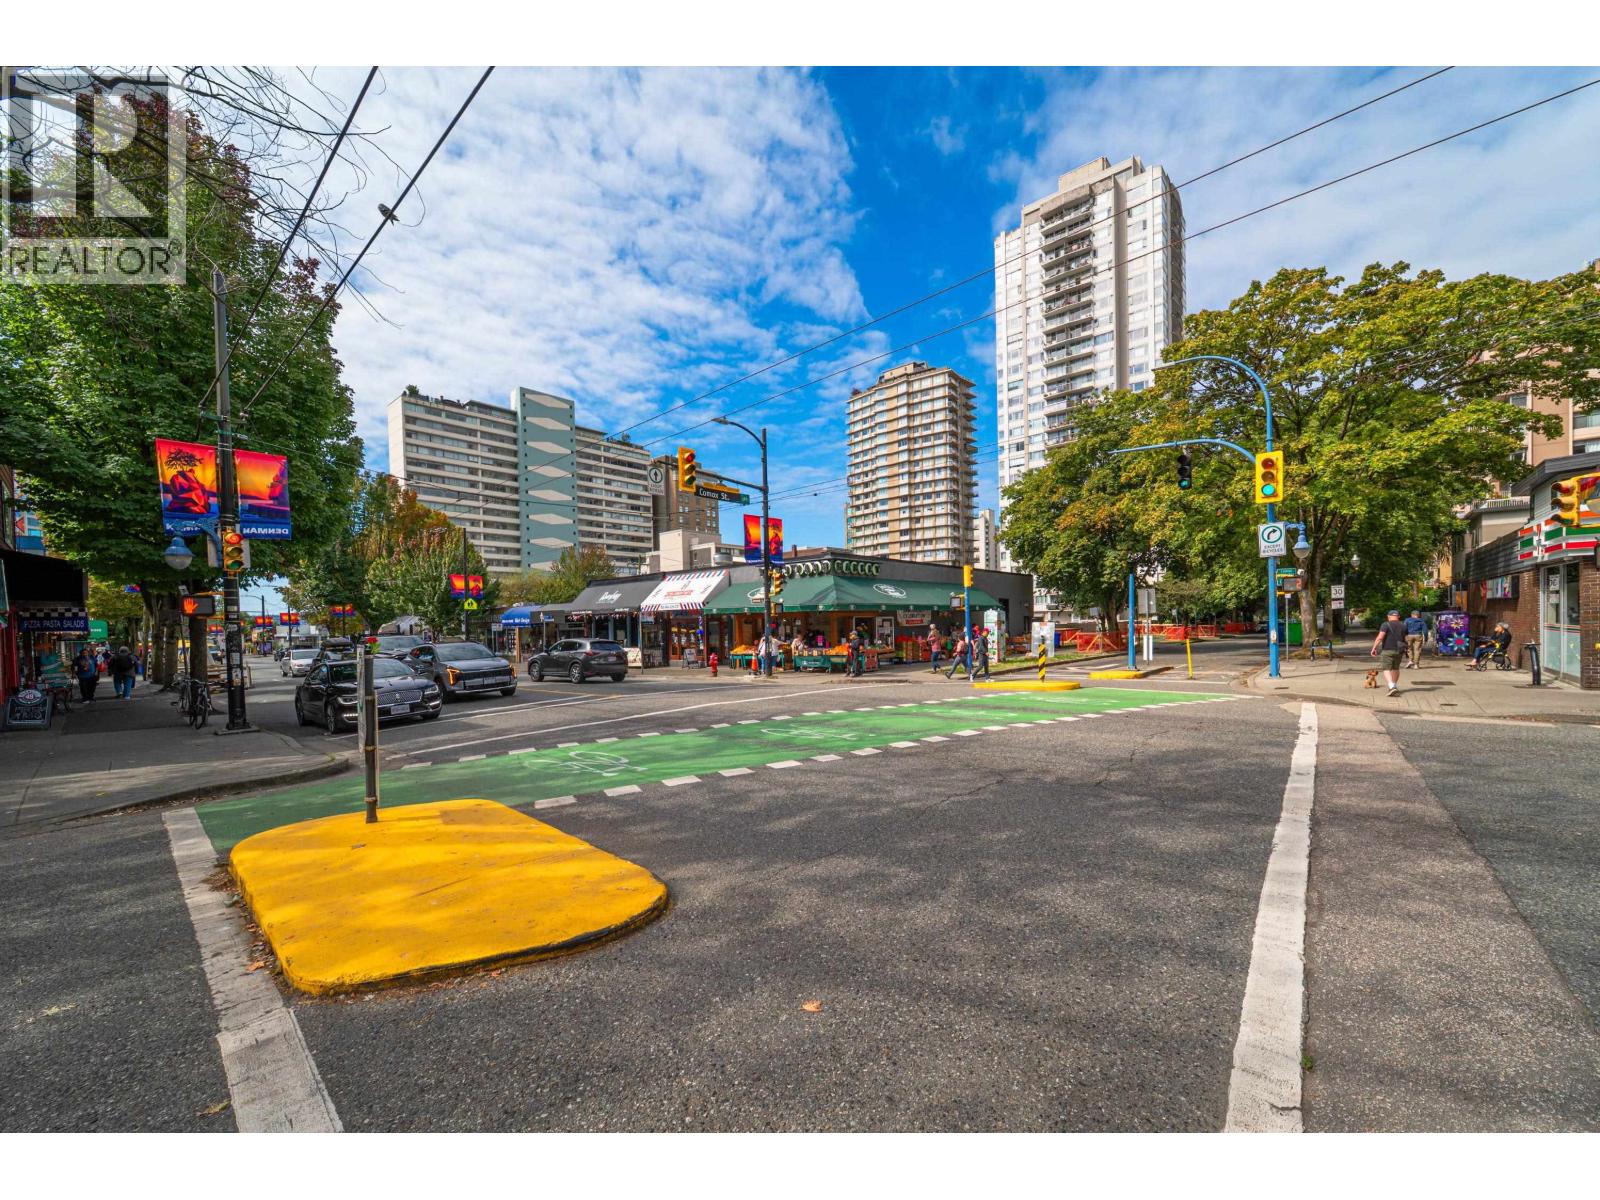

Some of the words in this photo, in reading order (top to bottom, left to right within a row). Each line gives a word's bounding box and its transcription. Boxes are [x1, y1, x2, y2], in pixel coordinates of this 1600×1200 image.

[1333, 588, 1343, 596] 30
[43, 620, 60, 628] PASTA
[63, 620, 84, 628] SALADS
